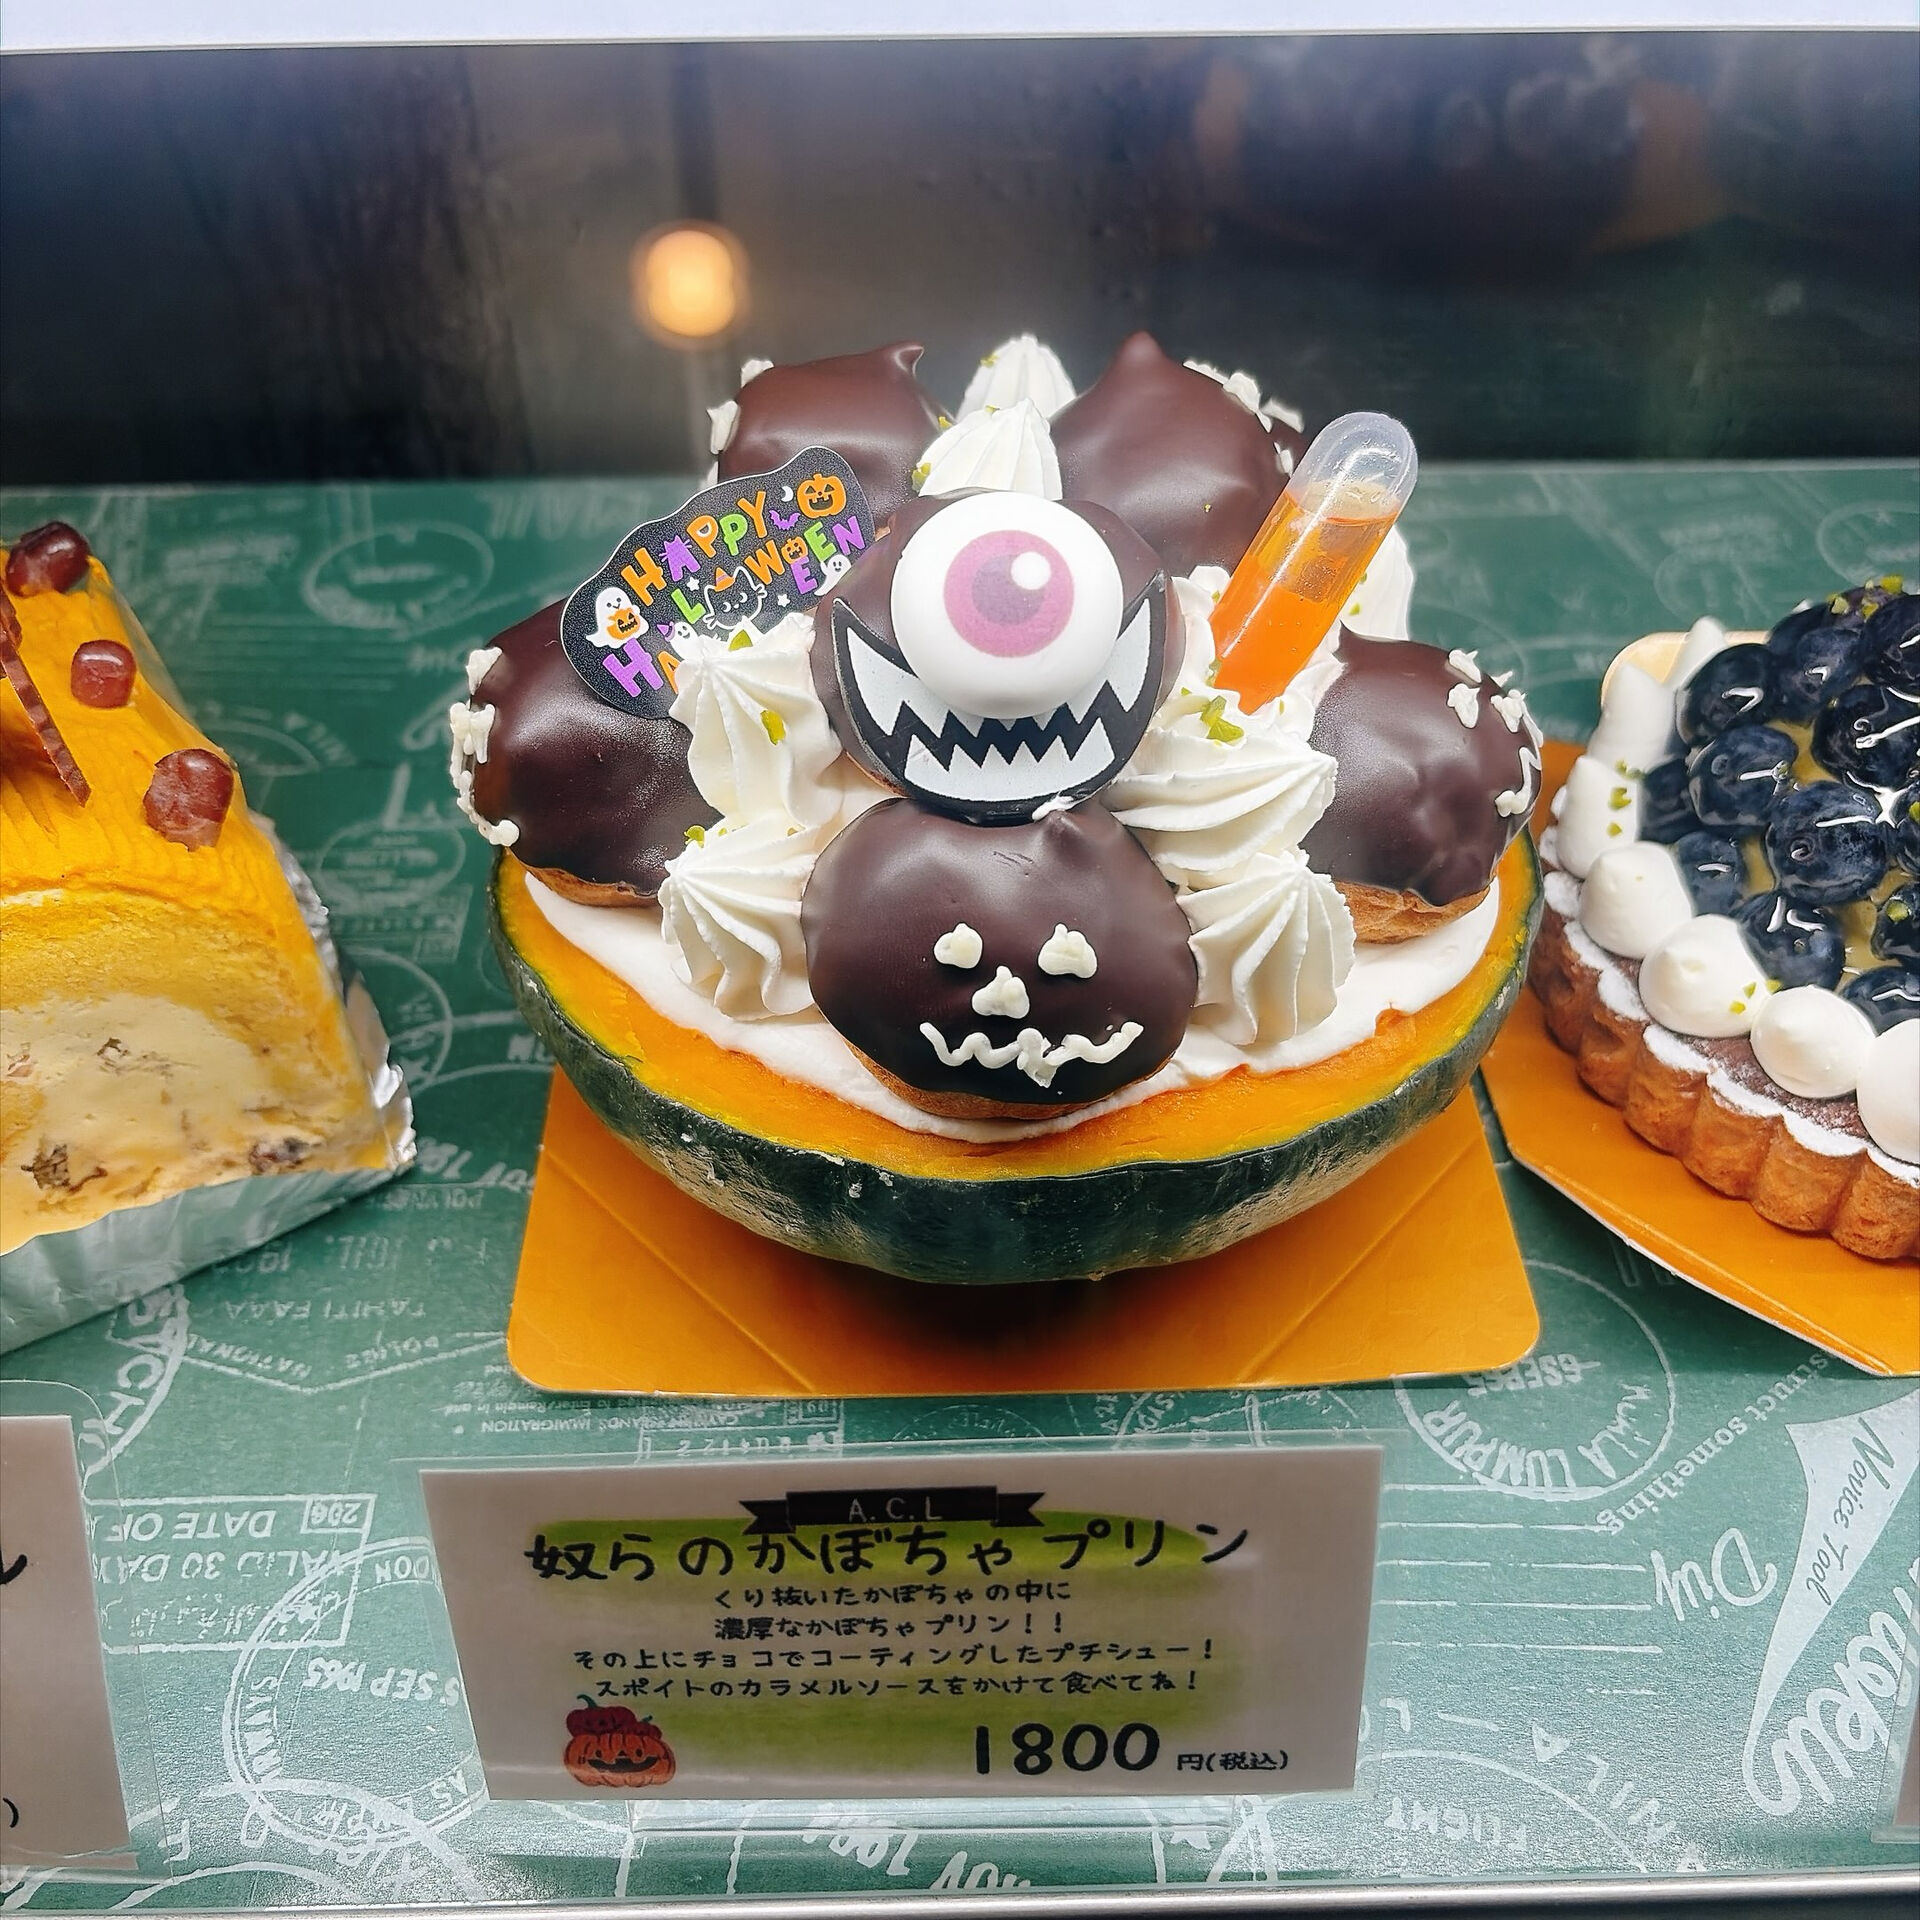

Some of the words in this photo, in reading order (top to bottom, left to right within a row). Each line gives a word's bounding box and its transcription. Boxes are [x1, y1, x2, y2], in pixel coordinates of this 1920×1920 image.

[621, 490, 766, 607] HAPPY
[481, 1418, 591, 1433] IMMIGRATION
[1422, 1400, 1576, 1489] LUMPUR
[1594, 1417, 1748, 1537] something
[1833, 1418, 1894, 1528] Novice
[105, 1512, 163, 1542] OF
[172, 1510, 276, 1539] DATE
[183, 1552, 225, 1580] 30
[524, 1518, 1248, 1581] 奴らのかぼちゃプリン
[1806, 1533, 1848, 1605] Tool
[714, 1579, 1071, 1609] くり抜いたかぼちゃの中に
[303, 1657, 366, 1692] 1965
[371, 1669, 438, 1701] SEP
[975, 1722, 1161, 1775] 1800
